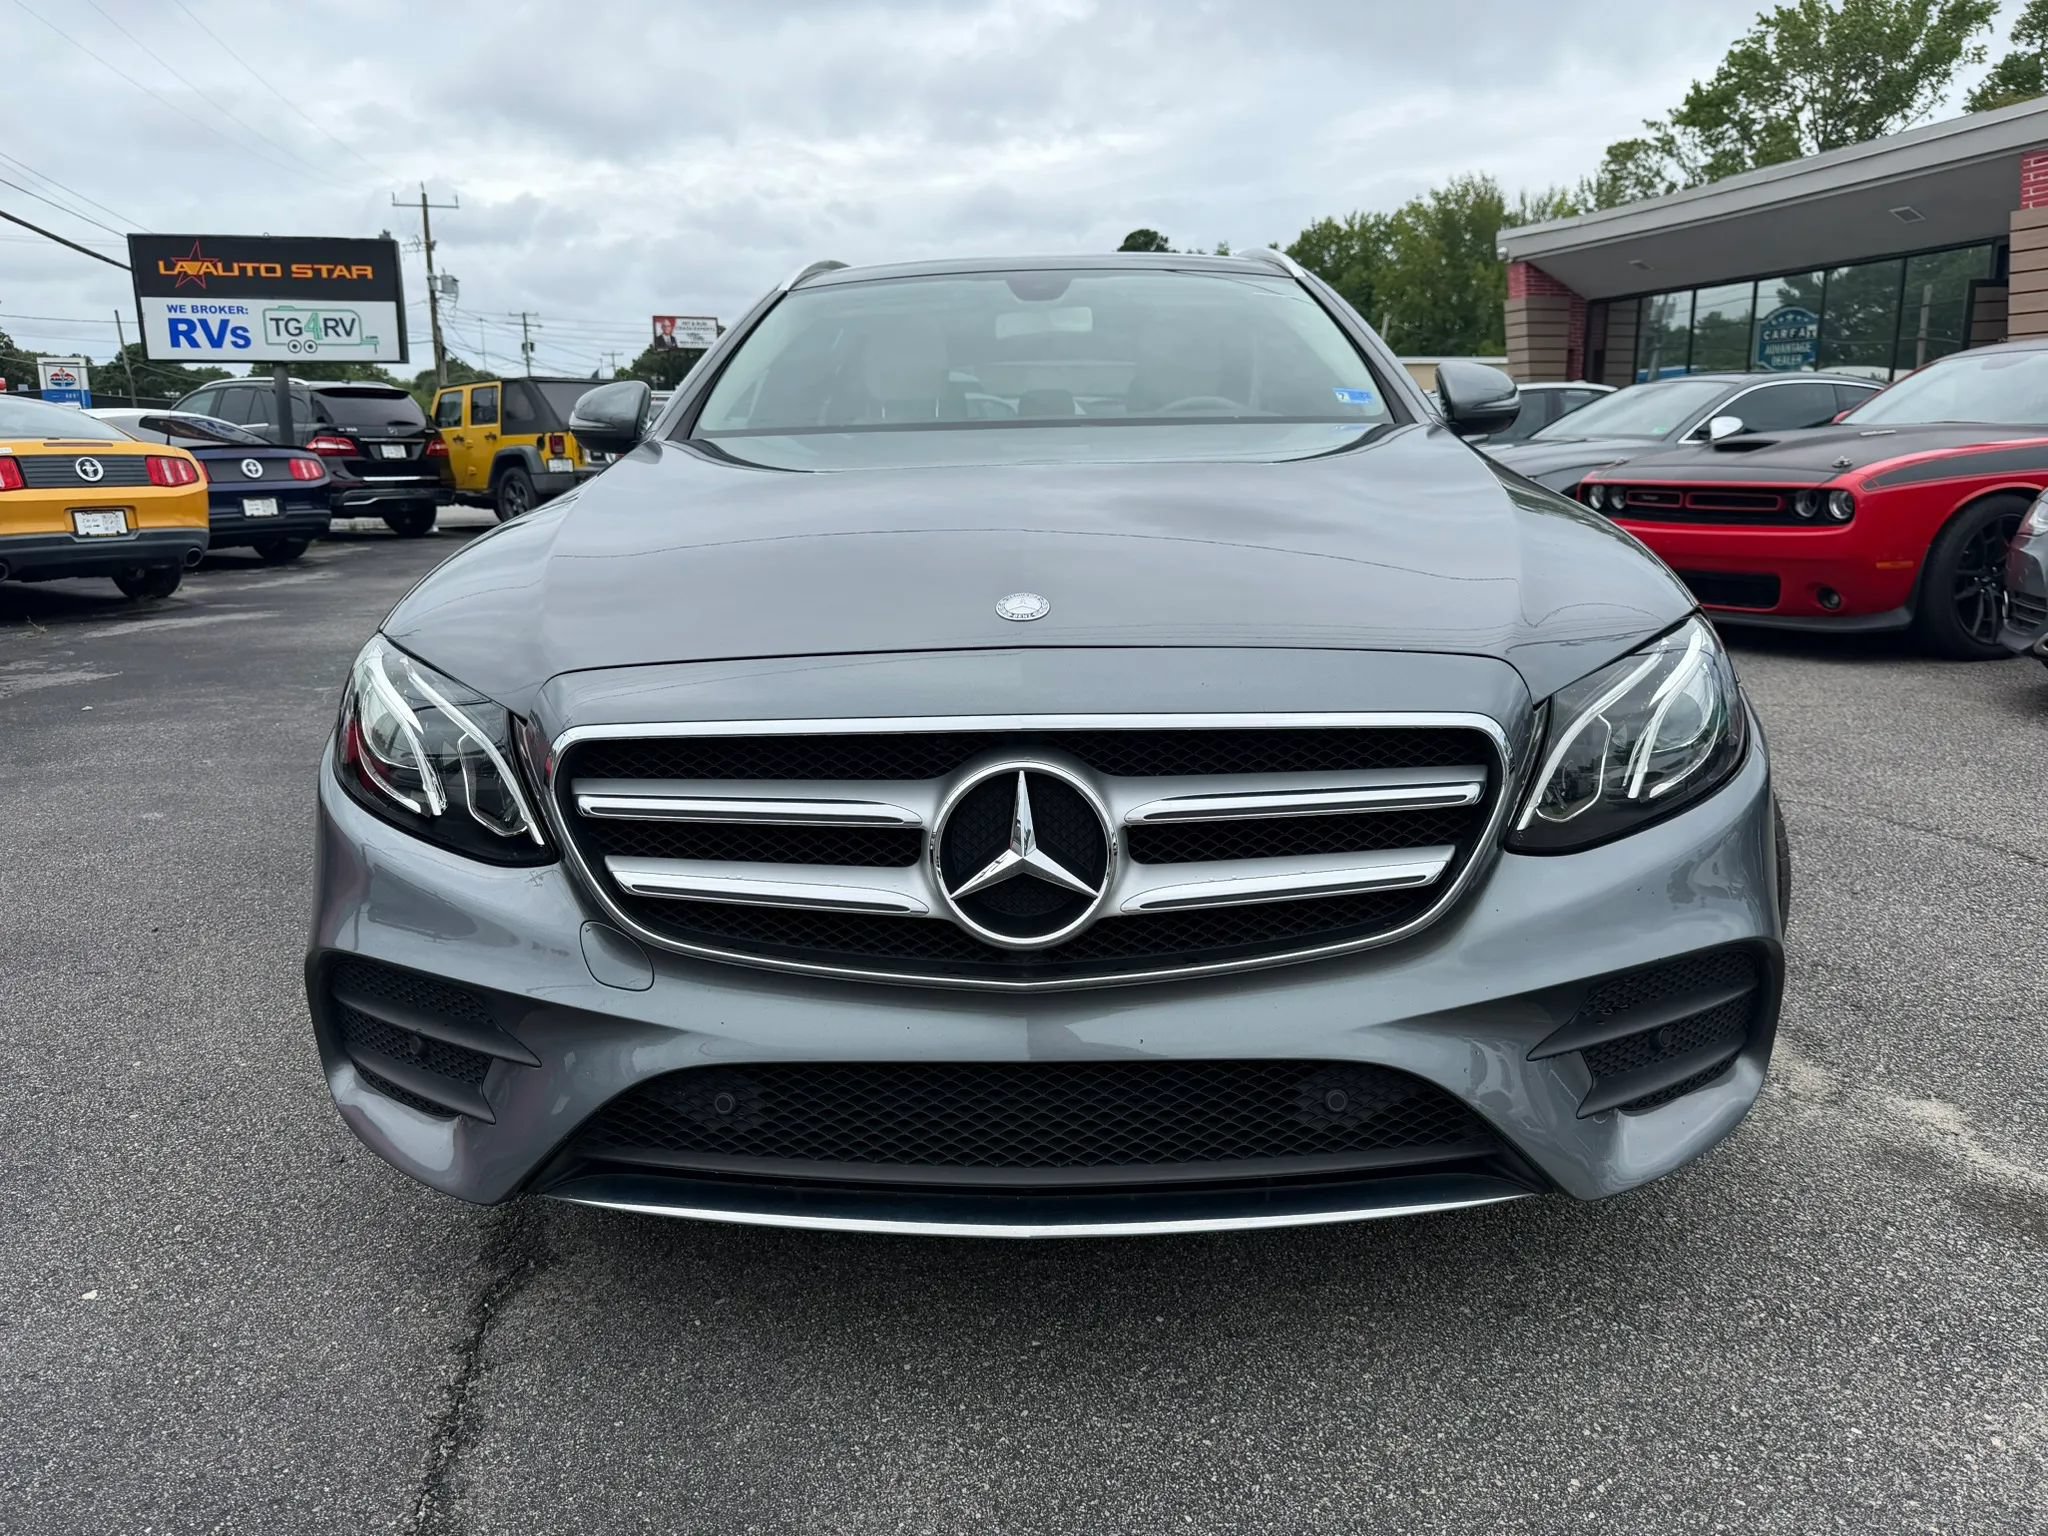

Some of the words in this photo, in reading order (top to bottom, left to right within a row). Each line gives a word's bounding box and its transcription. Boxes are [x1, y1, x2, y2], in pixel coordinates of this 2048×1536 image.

[199, 262, 280, 277] AUTO
[291, 264, 373, 279] STAR
[166, 304, 187, 314] WE
[191, 305, 249, 315] BROKER:
[168, 318, 251, 348] RVs
[269, 312, 355, 340] TG4RV
